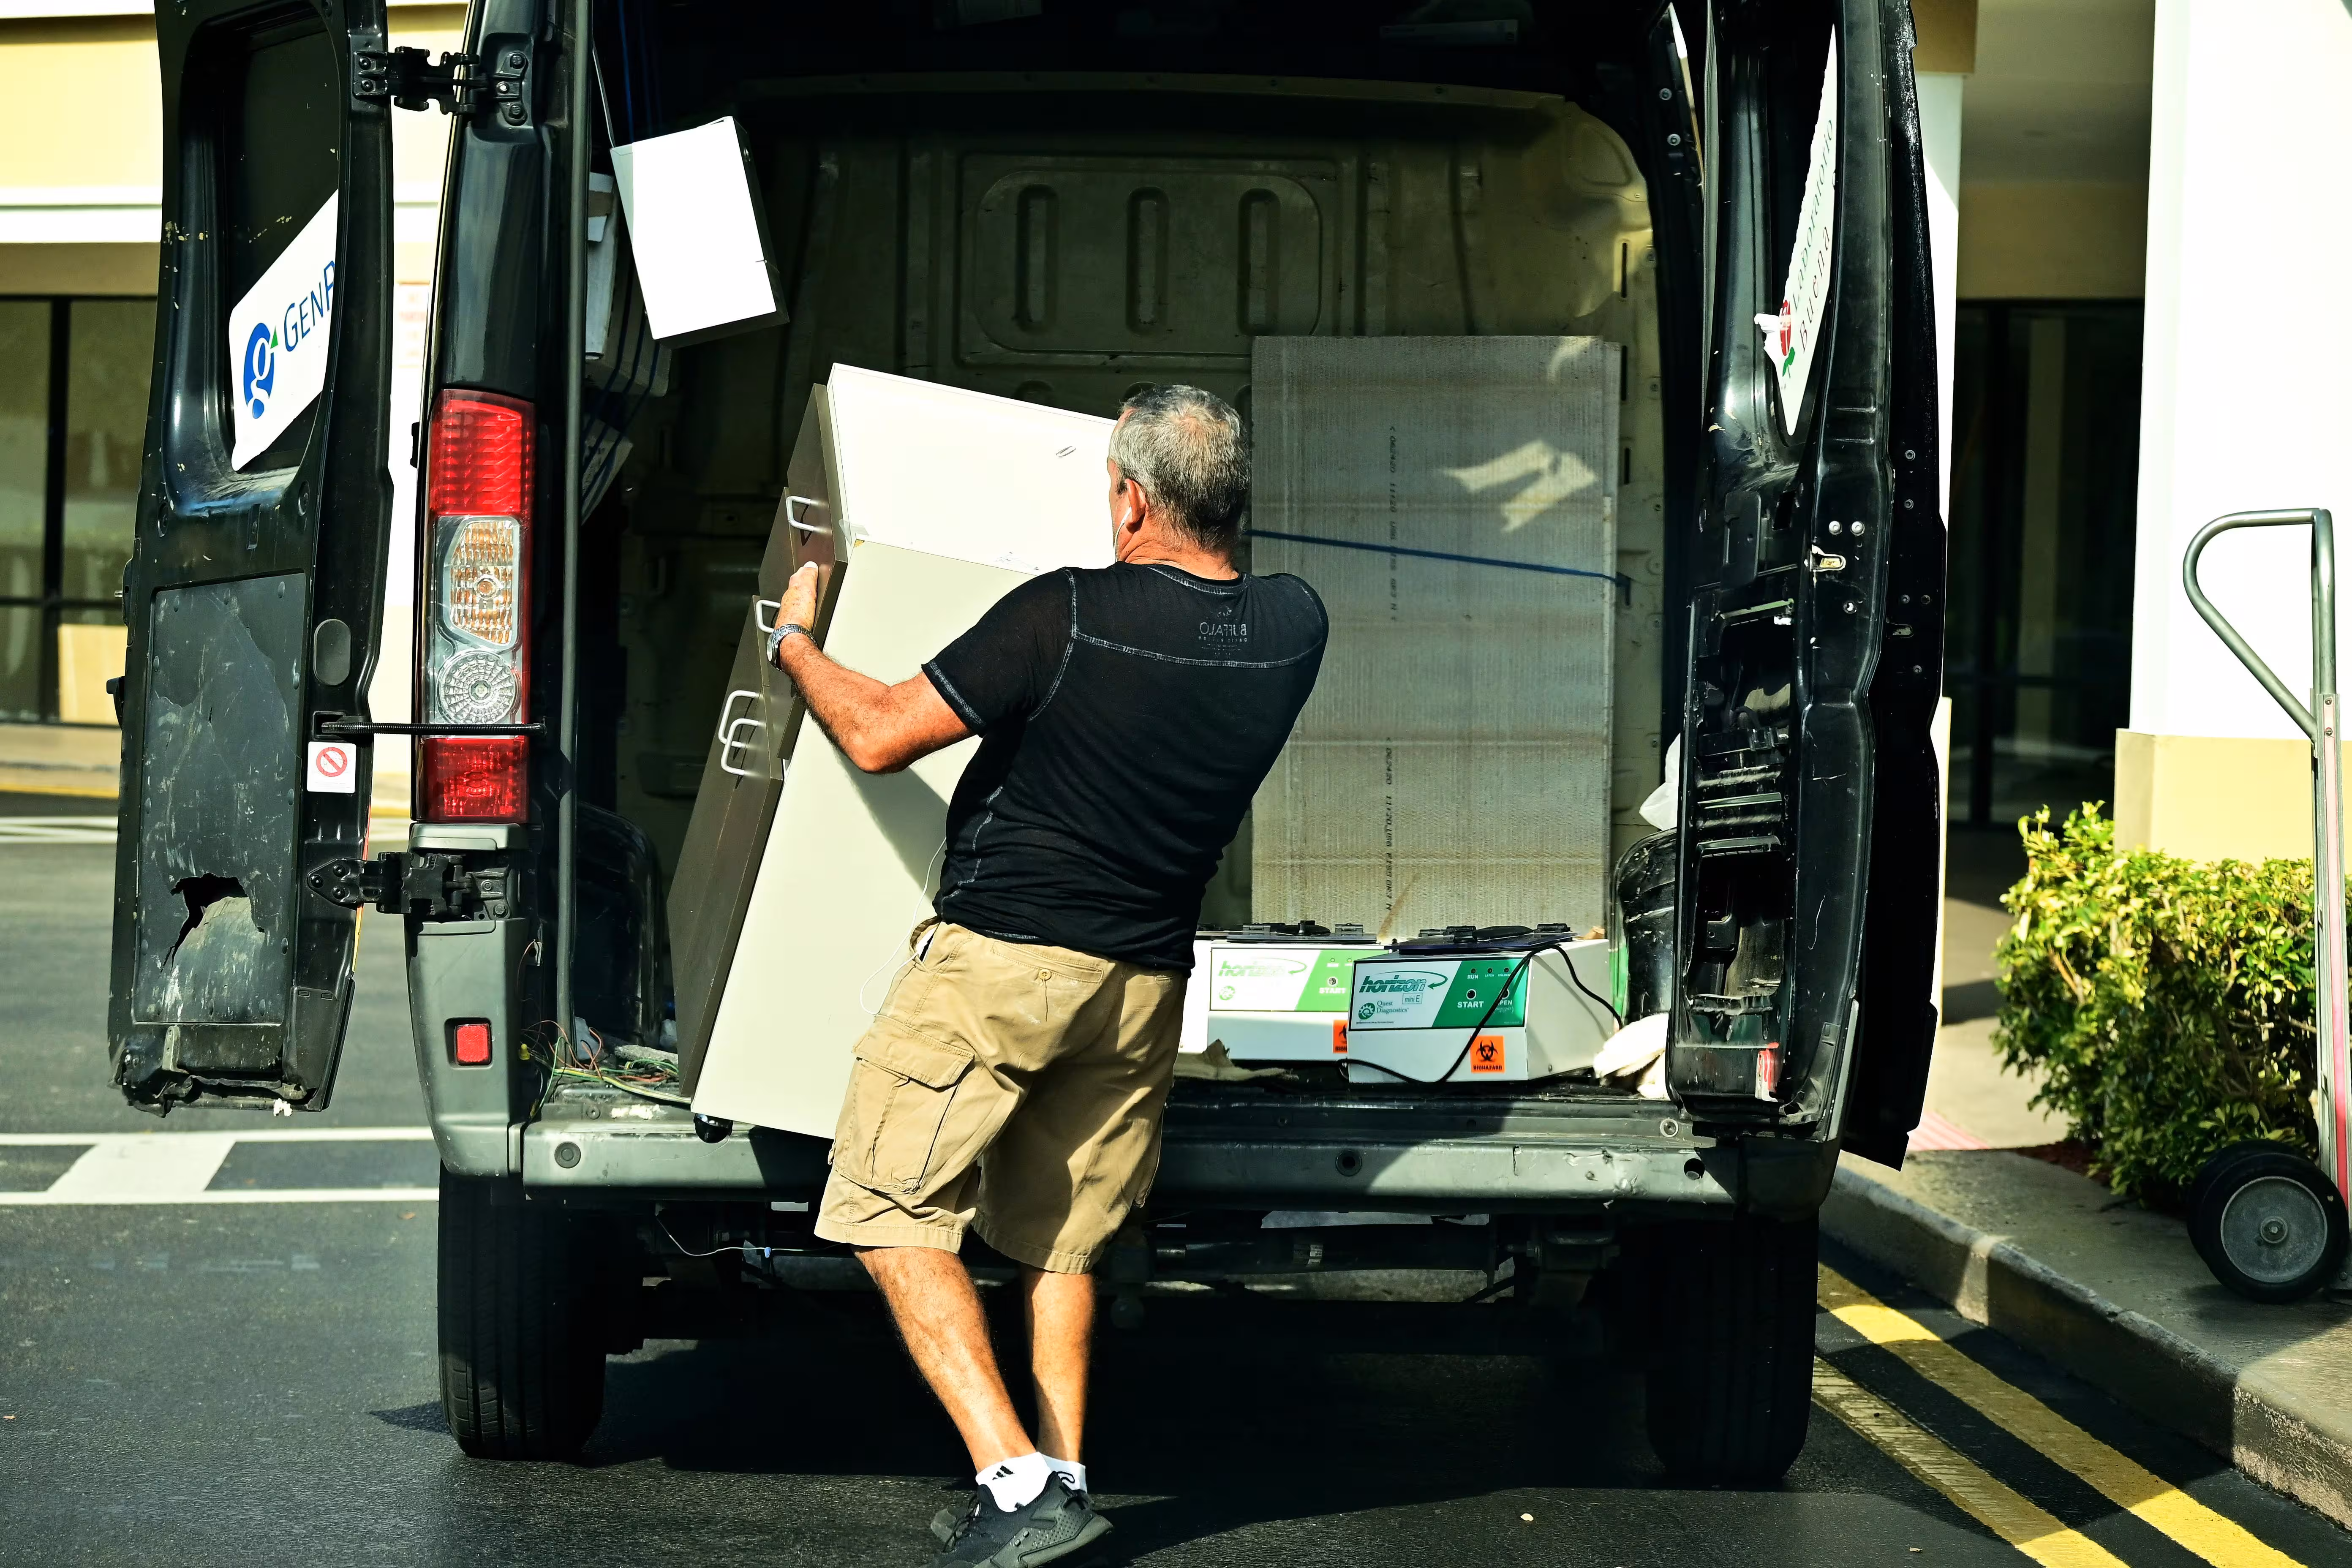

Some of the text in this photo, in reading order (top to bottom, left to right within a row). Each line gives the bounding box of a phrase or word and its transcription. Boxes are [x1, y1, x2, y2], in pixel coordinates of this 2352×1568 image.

[1793, 120, 1832, 312] Laboratorio
[1800, 226, 1830, 354] Buena
[1358, 975, 1426, 993] horizon
